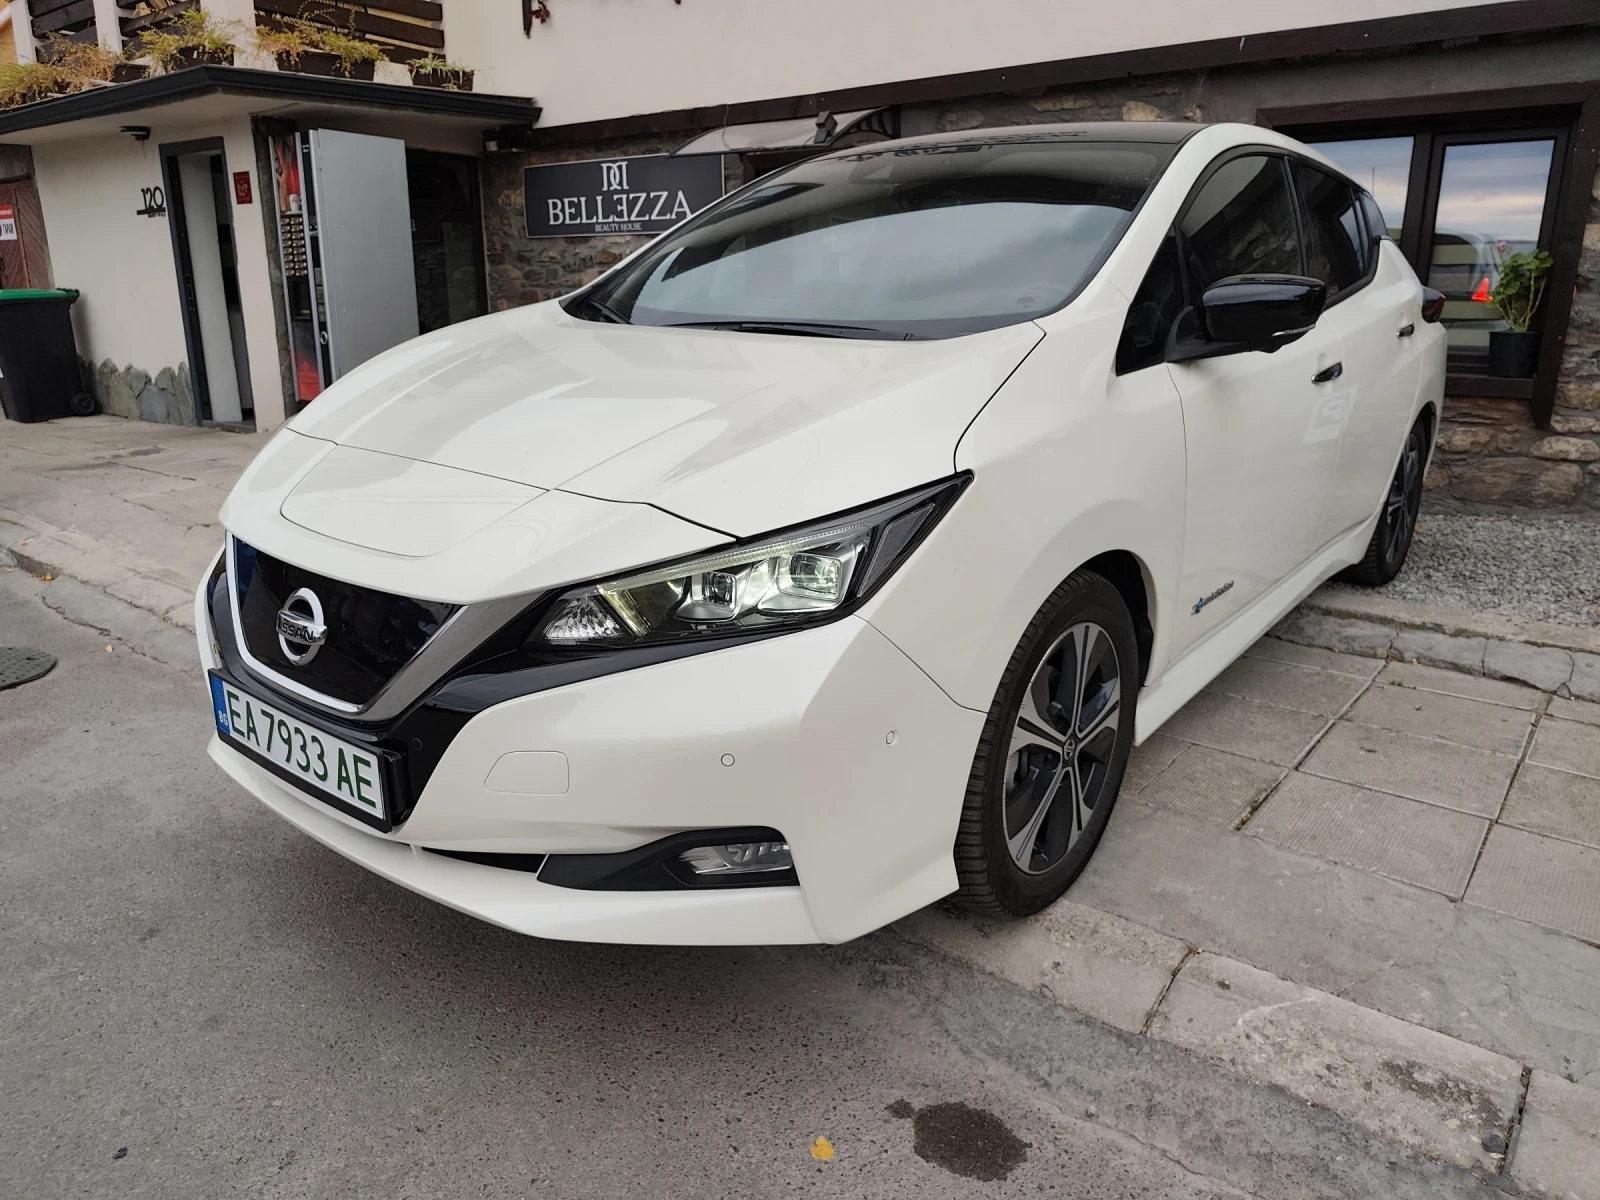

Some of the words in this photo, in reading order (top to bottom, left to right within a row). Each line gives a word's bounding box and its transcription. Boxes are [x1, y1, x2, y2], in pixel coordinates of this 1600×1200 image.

[141, 186, 164, 209] 120
[595, 223, 619, 232] BEAUTY
[620, 222, 642, 231] HOUSE
[218, 710, 229, 726] BG
